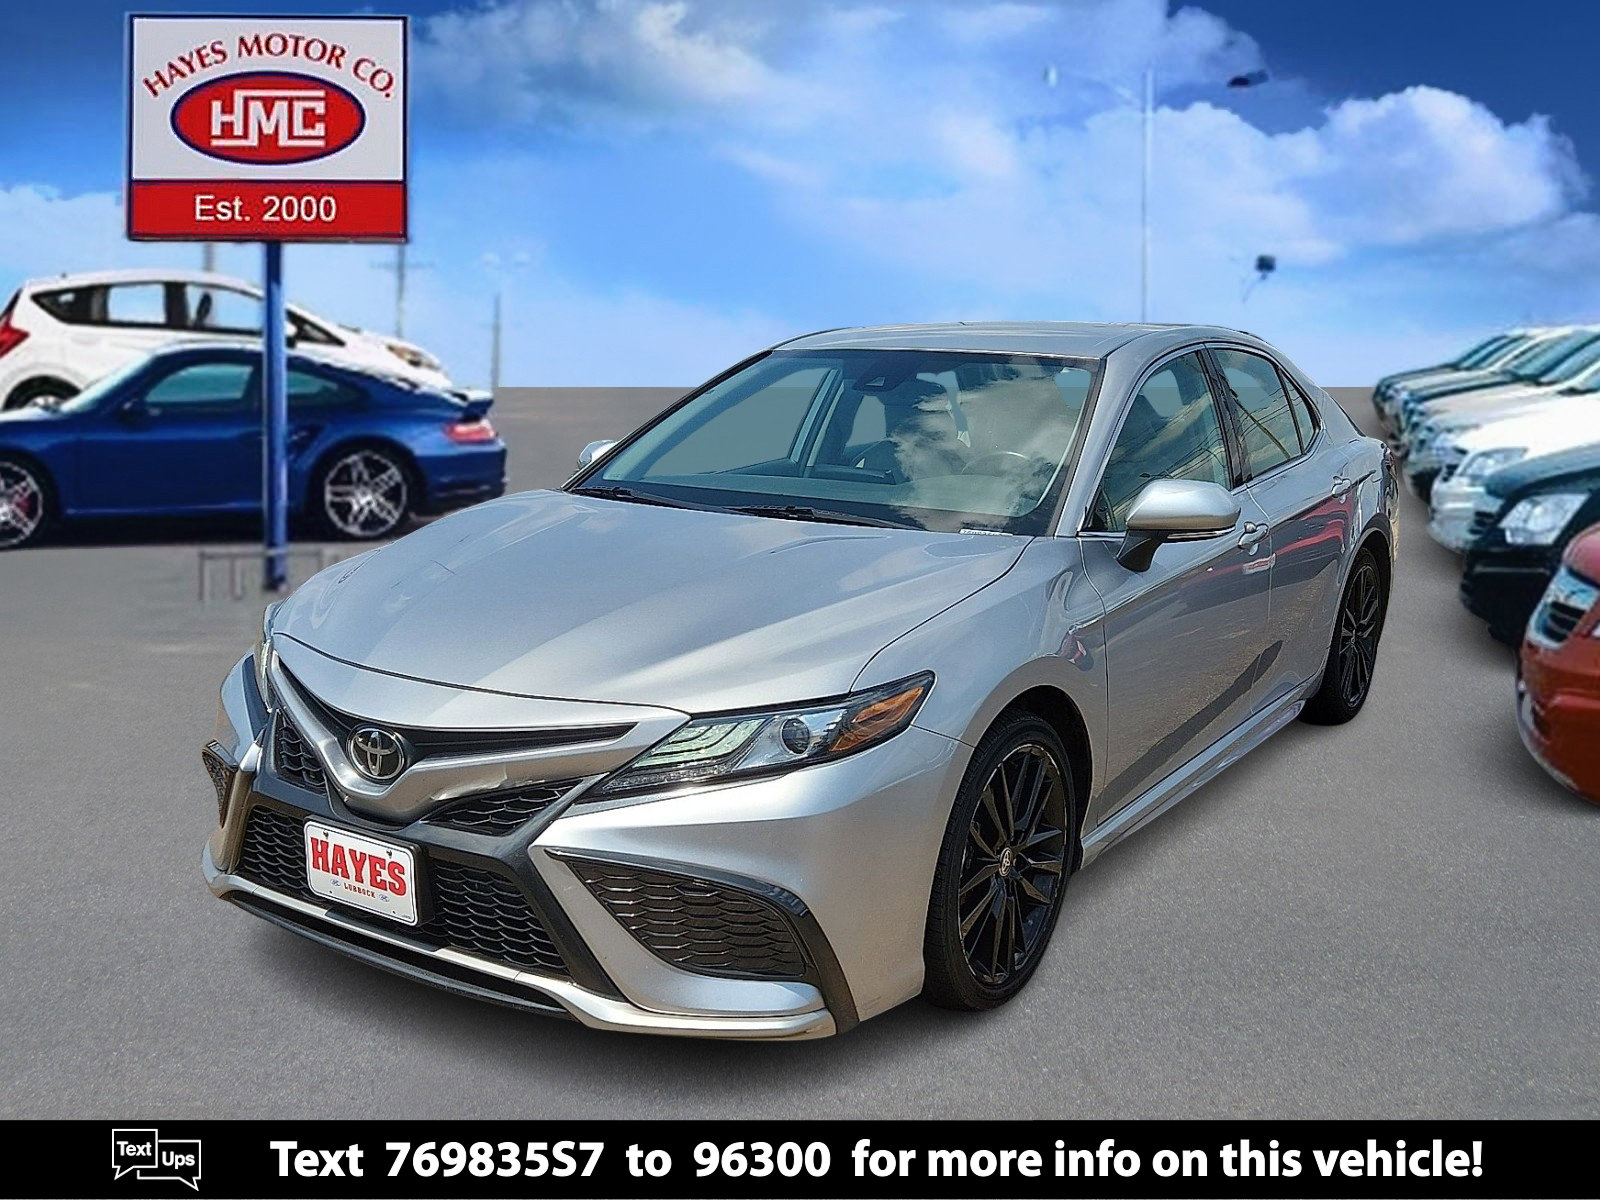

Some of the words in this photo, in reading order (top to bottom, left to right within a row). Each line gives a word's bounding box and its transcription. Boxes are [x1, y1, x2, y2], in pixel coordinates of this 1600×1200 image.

[142, 40, 228, 98] HAYES
[237, 32, 347, 70] MOTOR
[352, 57, 394, 98] CO.
[210, 89, 327, 148] HMC
[195, 195, 250, 221] Est.
[262, 195, 337, 221] 2000
[310, 837, 407, 896] HAYES
[343, 882, 376, 898] LUBBOCK
